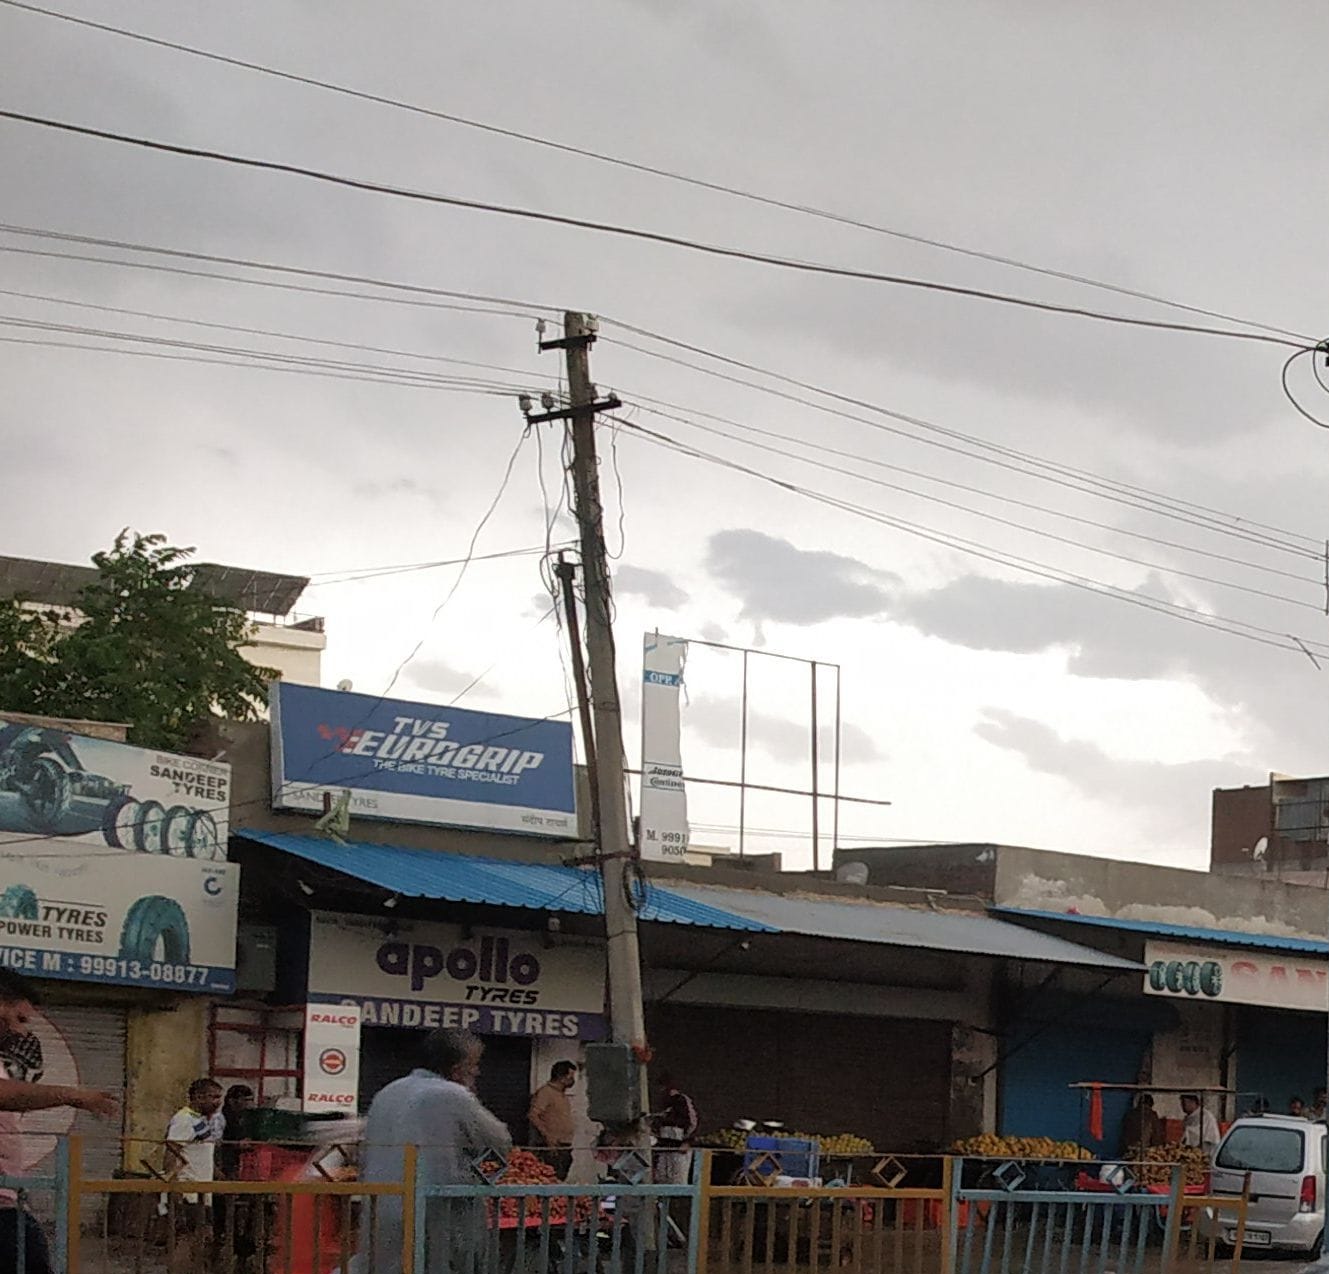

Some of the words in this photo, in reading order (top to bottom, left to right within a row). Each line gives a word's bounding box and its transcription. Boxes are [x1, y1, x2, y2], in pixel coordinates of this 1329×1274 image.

[394, 716, 450, 740] TVS
[349, 730, 544, 774] EUROGRIP
[150, 764, 227, 789] SANDEEP
[373, 758, 396, 772] THE
[397, 761, 425, 775] BIKE
[426, 764, 456, 779] TYRE
[457, 767, 520, 785] SPECIALIST
[172, 781, 226, 803] TYRES
[43, 906, 108, 928] TYRES
[58, 926, 103, 944] TYRES
[43, 952, 60, 971] M
[80, 955, 208, 986] 99913-08877
[376, 936, 540, 992] apollo
[464, 985, 540, 1005] TYRES
[310, 1013, 358, 1025] RALCO
[341, 999, 480, 1030] ANDEEP
[491, 1011, 579, 1037] TYRES
[307, 1093, 355, 1105] RALCO
